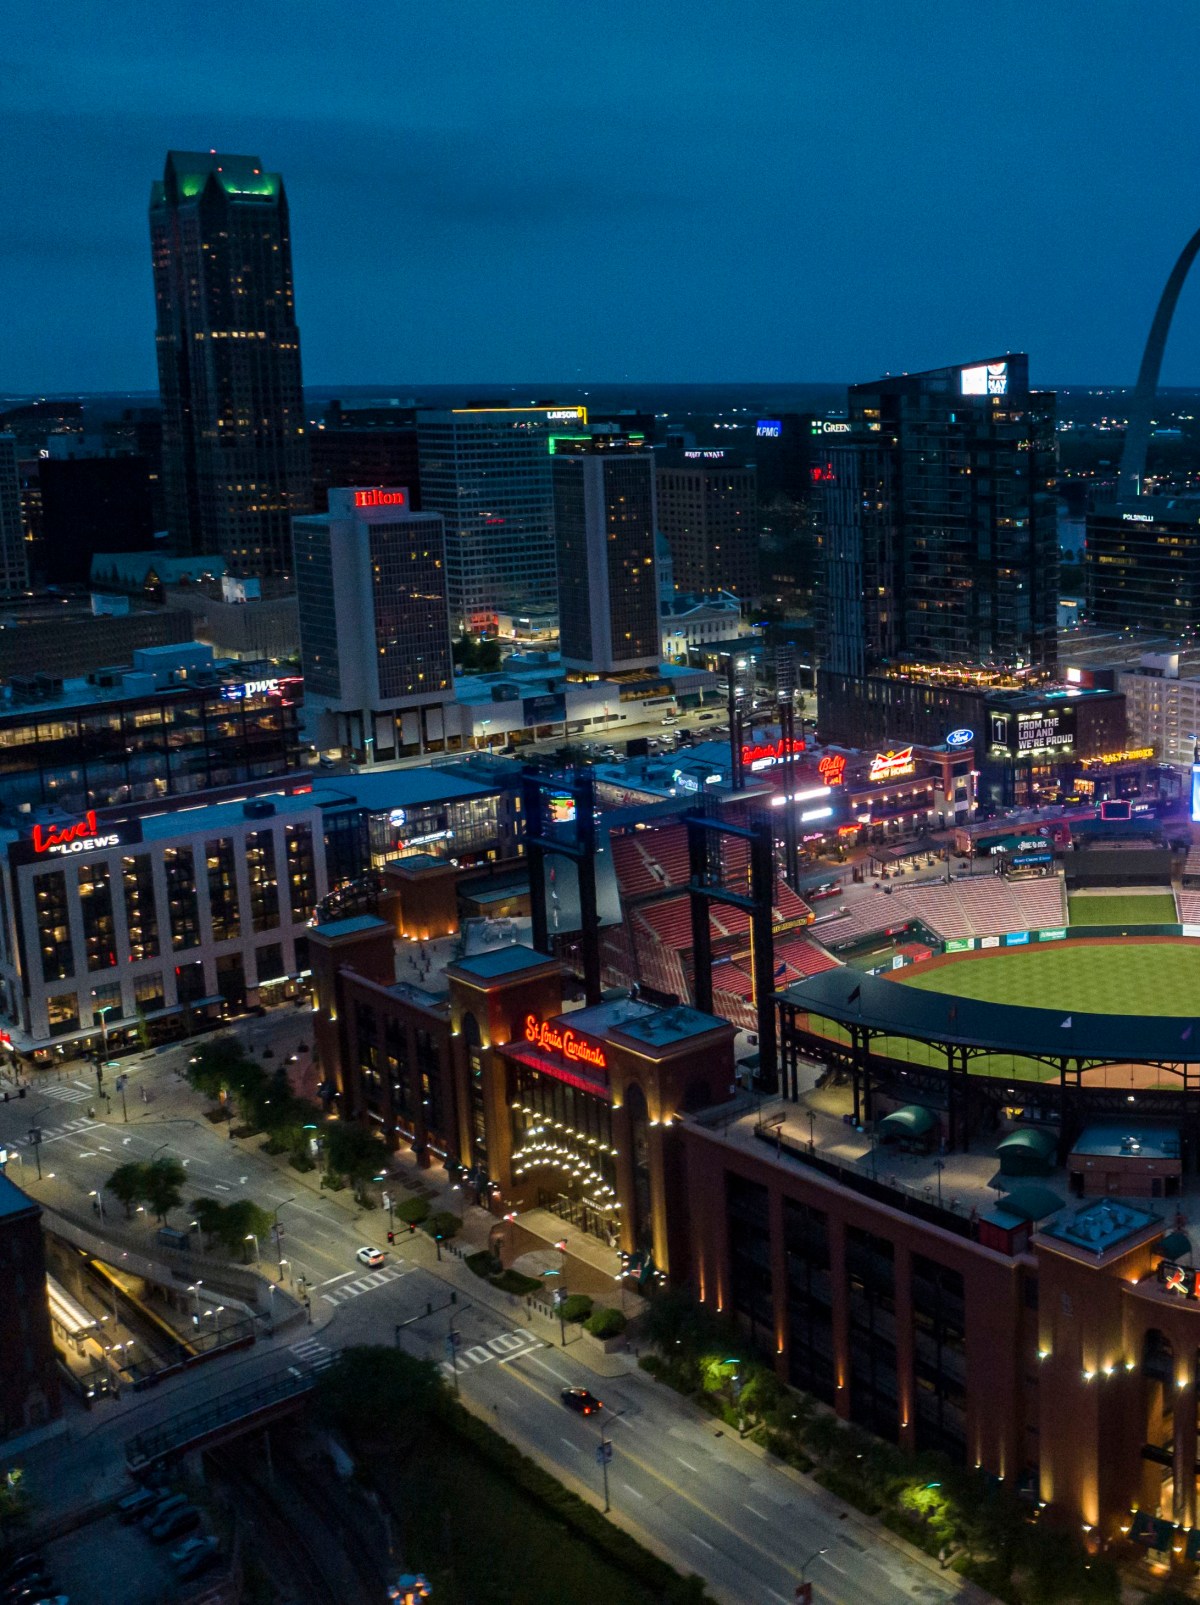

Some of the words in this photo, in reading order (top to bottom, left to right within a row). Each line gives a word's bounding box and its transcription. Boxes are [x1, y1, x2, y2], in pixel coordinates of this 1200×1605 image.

[547, 411, 577, 419] LARSON
[756, 427, 778, 437] KPMG
[355, 489, 404, 506] Hilton
[244, 679, 279, 698] pwc
[1018, 719, 1042, 731] FROM
[1043, 717, 1060, 728] THE
[1018, 730, 1035, 740] LOU
[1036, 727, 1054, 737] AND
[1018, 738, 1045, 750] WE'RE
[1046, 733, 1073, 746] PROUD
[819, 755, 845, 773] Bally
[870, 769, 890, 780] BREW
[890, 763, 915, 776] HOUSE
[33, 809, 97, 853] Live!
[61, 834, 120, 854] LOEWS
[525, 1015, 540, 1041] St.
[538, 1022, 562, 1052] Louis
[563, 1030, 606, 1067] Cardinals
